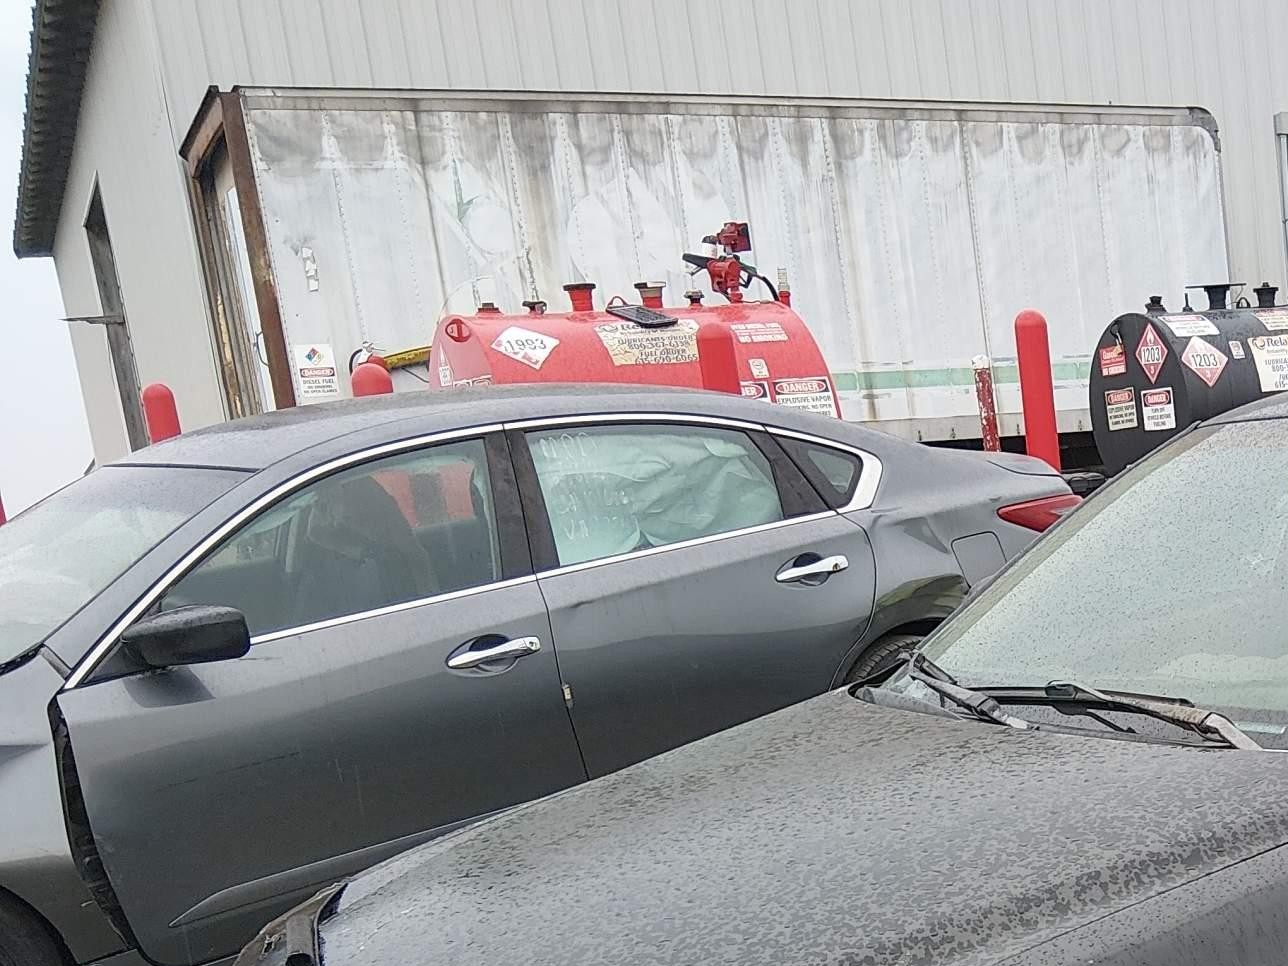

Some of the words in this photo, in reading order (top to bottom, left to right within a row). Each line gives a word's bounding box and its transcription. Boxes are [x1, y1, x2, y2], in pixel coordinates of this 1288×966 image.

[618, 336, 665, 345] LUBRICANTS
[1142, 346, 1160, 363] 1203
[1192, 353, 1218, 367] 1203
[304, 368, 330, 377] DANGER
[782, 381, 820, 393] DANGER
[777, 396, 811, 405] EXPLOSIVE
[1110, 392, 1129, 403] DANGER
[1147, 393, 1166, 404] DANGER
